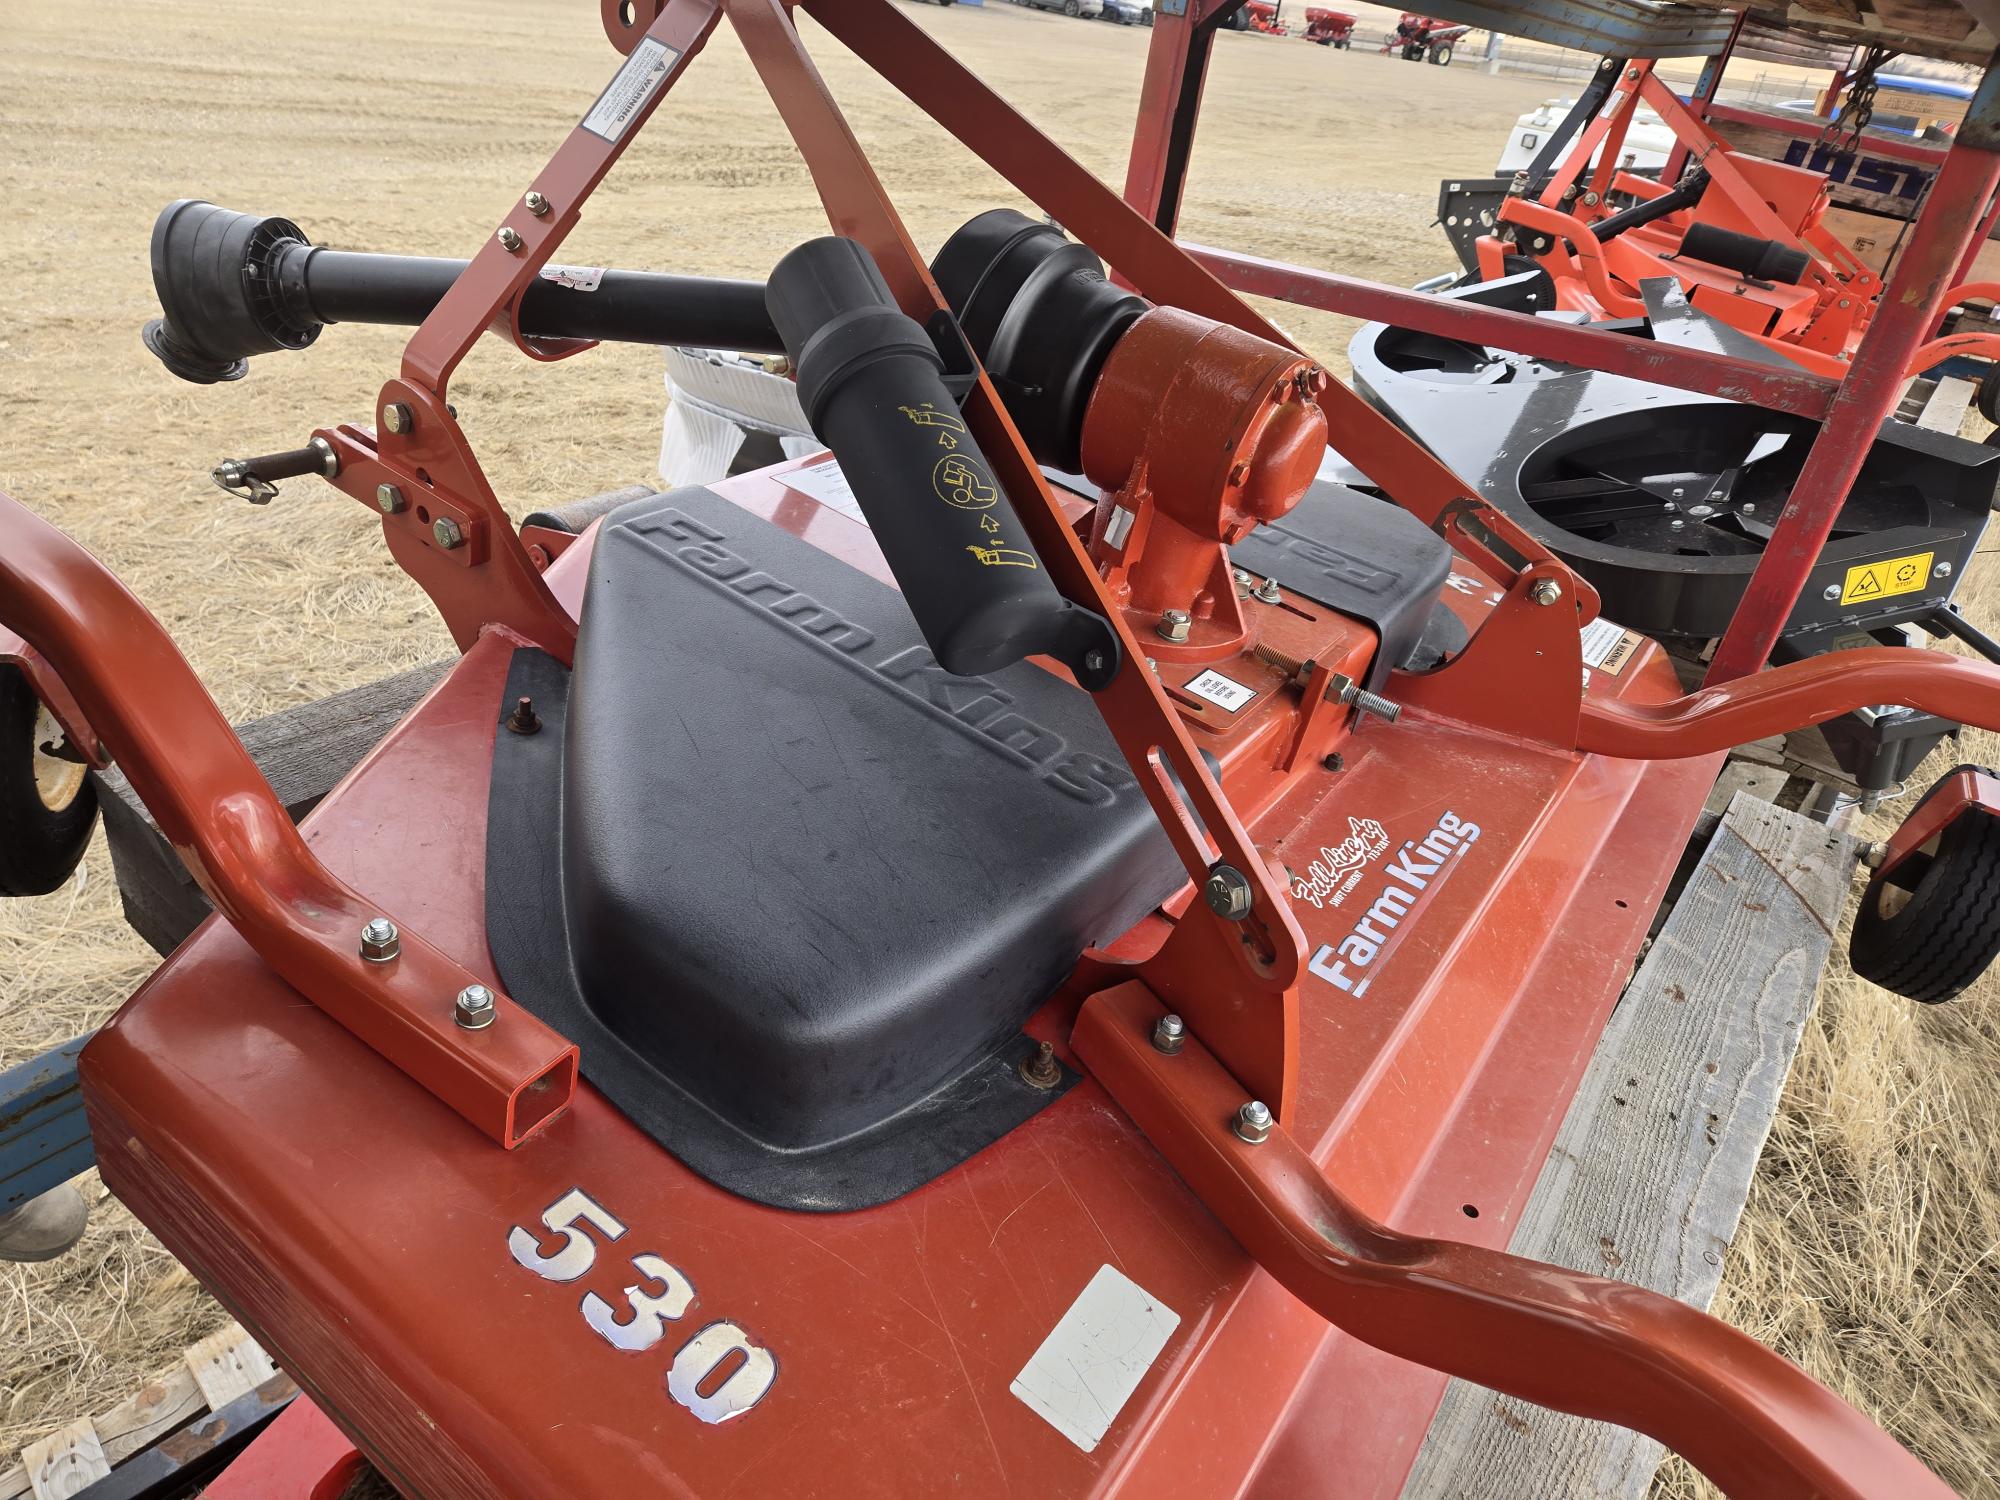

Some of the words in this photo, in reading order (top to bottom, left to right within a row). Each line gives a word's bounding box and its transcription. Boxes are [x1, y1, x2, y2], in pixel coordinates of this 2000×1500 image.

[616, 77, 653, 123] WARNING
[637, 507, 875, 653] Farm
[1895, 580, 1914, 588] STOP
[1605, 645, 1628, 667] WARNING
[1291, 861, 1336, 908] Full
[1321, 838, 1364, 868] Line
[1347, 816, 1388, 850] Ag
[1329, 890, 1347, 907] SWIFT
[1341, 869, 1364, 893] CURRENT
[1308, 885, 1416, 992] Farm
[1384, 810, 1481, 890] King
[507, 1186, 779, 1424] 530
